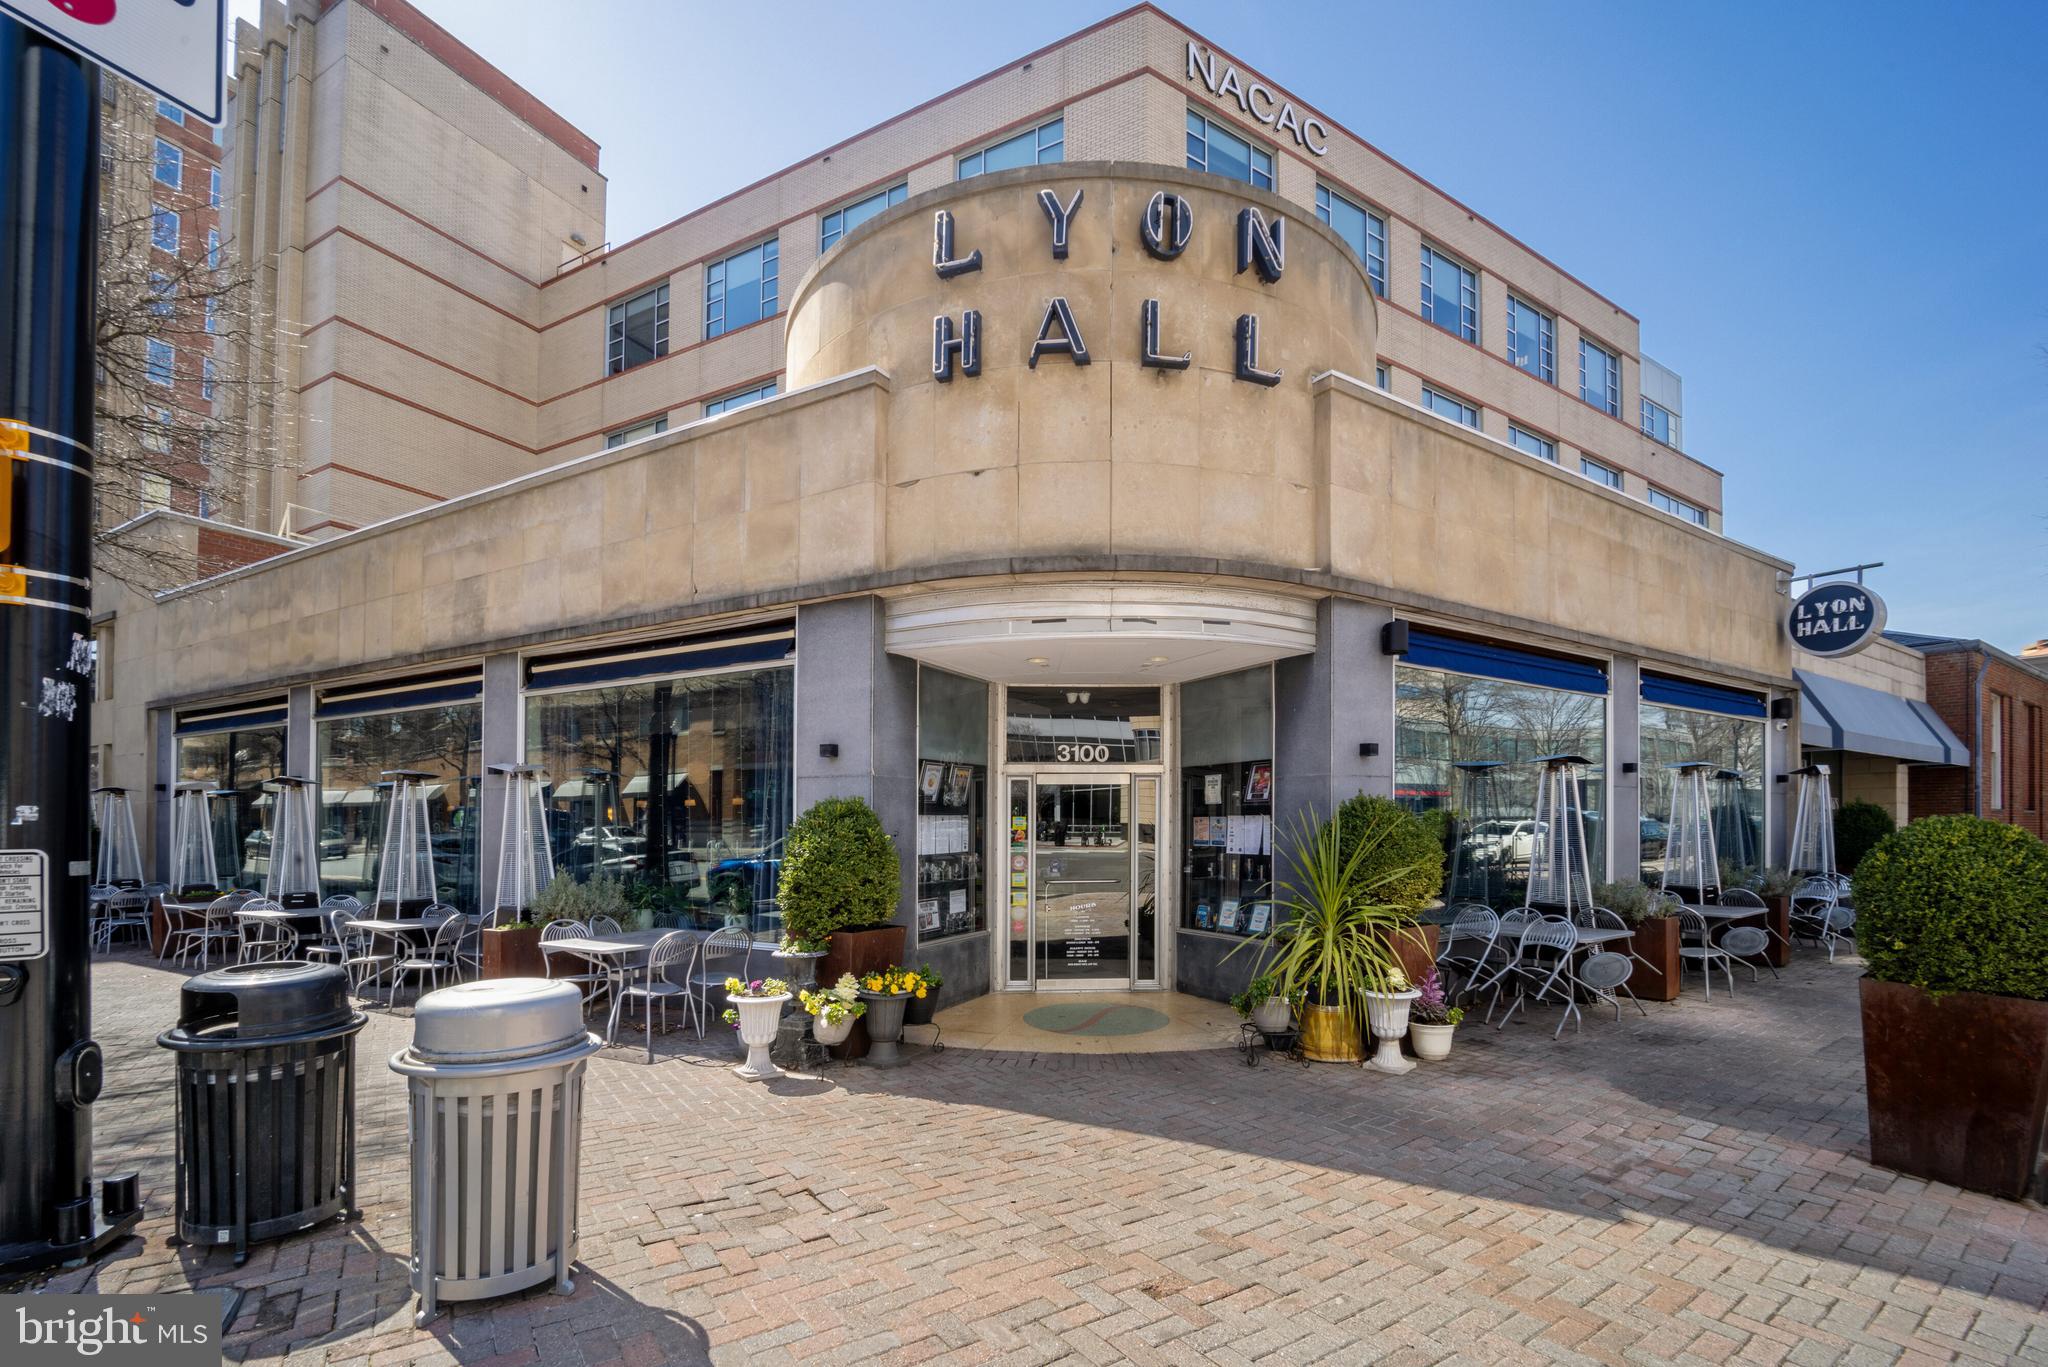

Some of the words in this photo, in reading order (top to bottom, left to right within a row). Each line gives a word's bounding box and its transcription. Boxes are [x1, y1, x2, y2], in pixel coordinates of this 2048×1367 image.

[1186, 40, 1329, 157] NACAC
[932, 188, 1286, 284] LYON
[932, 297, 1285, 388] HALL
[1797, 595, 1866, 620] LYON
[1797, 615, 1865, 637] HALL
[1057, 744, 1109, 762] 3100
